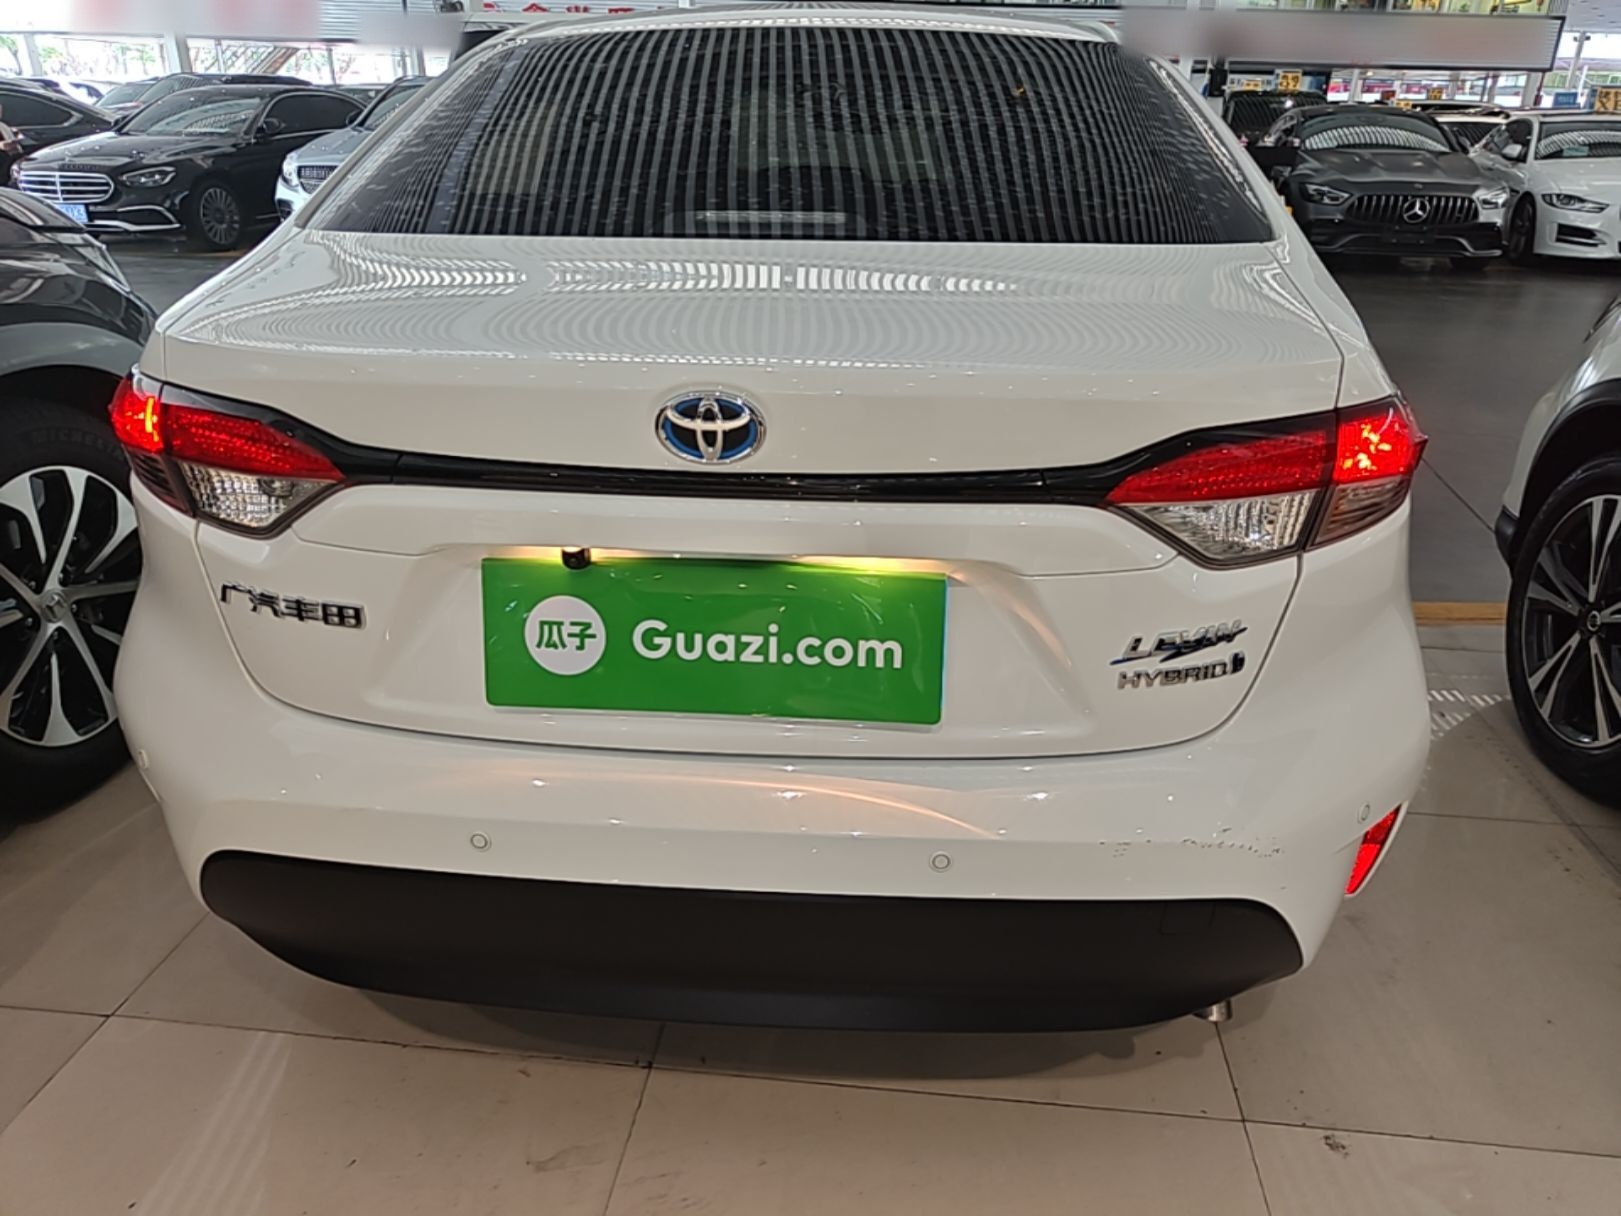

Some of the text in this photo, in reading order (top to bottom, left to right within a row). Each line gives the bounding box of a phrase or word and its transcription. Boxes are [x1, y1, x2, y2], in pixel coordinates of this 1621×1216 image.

[221, 583, 364, 629] 广汽丰田
[535, 619, 597, 652] 瓜子
[631, 618, 903, 669] Guazi.com
[1117, 660, 1229, 690] HYBRID
